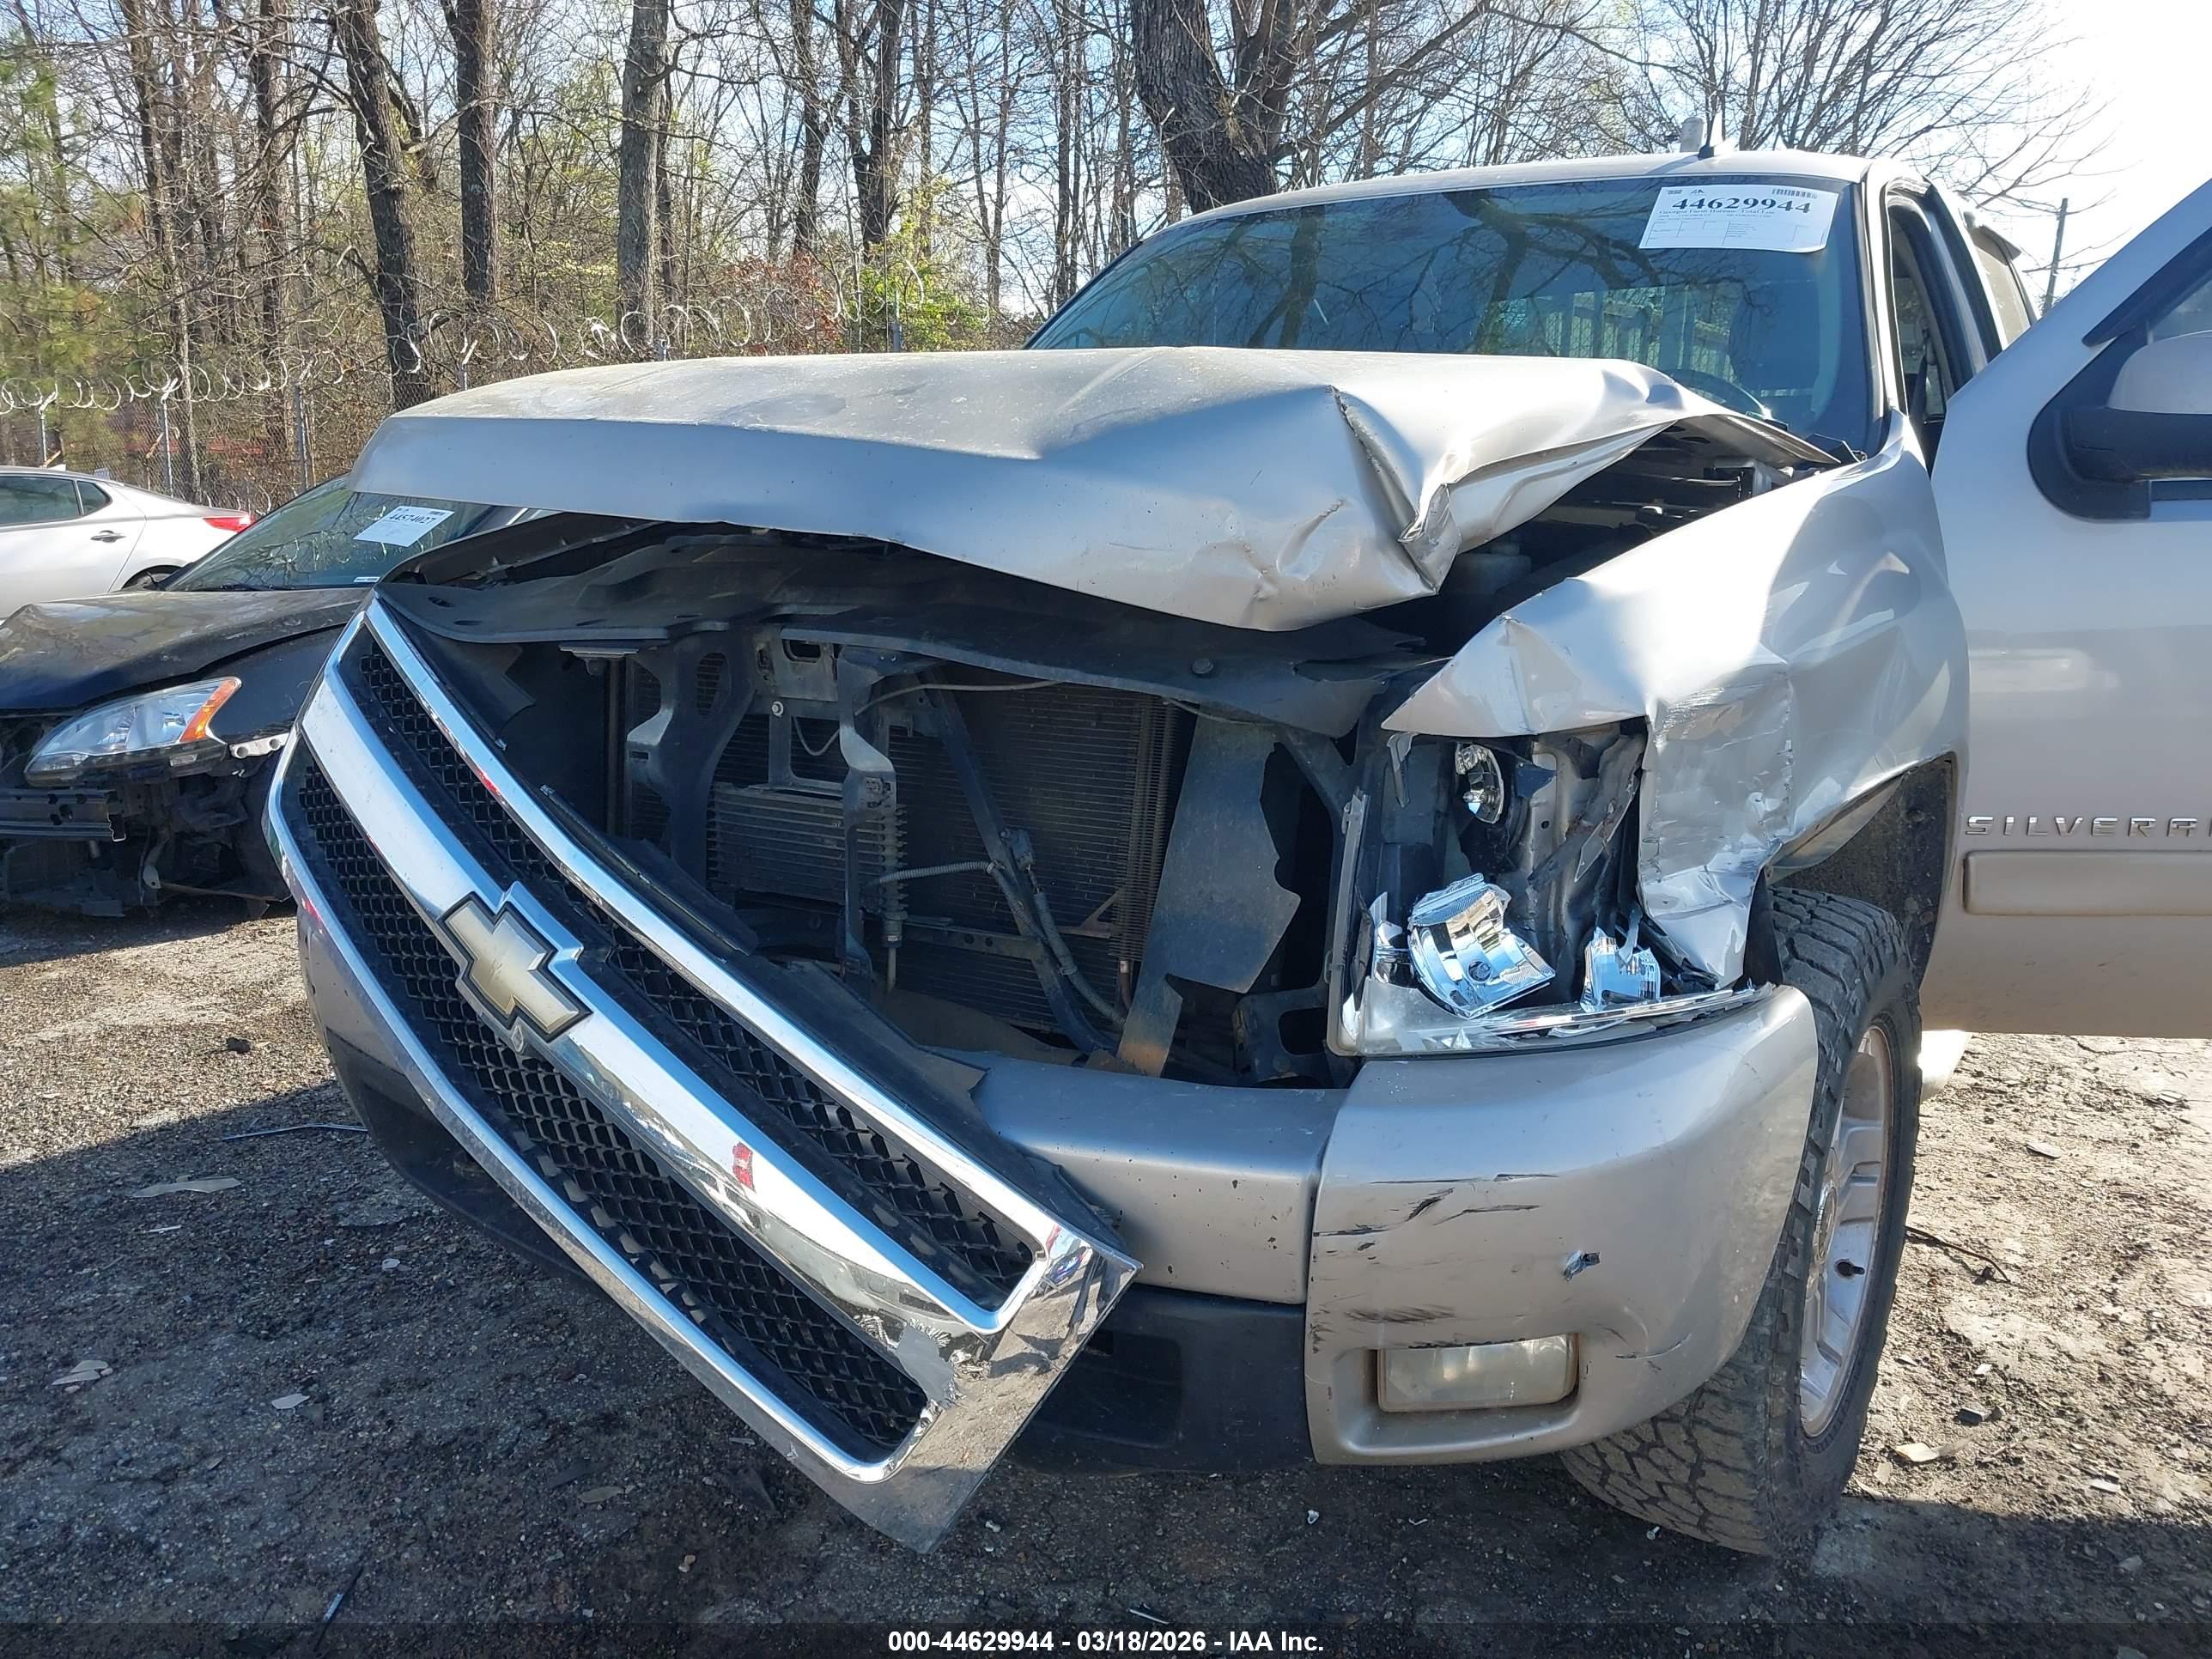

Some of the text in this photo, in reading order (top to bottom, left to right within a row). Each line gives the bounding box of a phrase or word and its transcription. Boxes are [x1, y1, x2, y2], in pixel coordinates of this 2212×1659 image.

[1672, 198, 1811, 214] 44629944
[389, 514, 437, 525] 44574027
[1966, 816, 2212, 838] SILVERA
